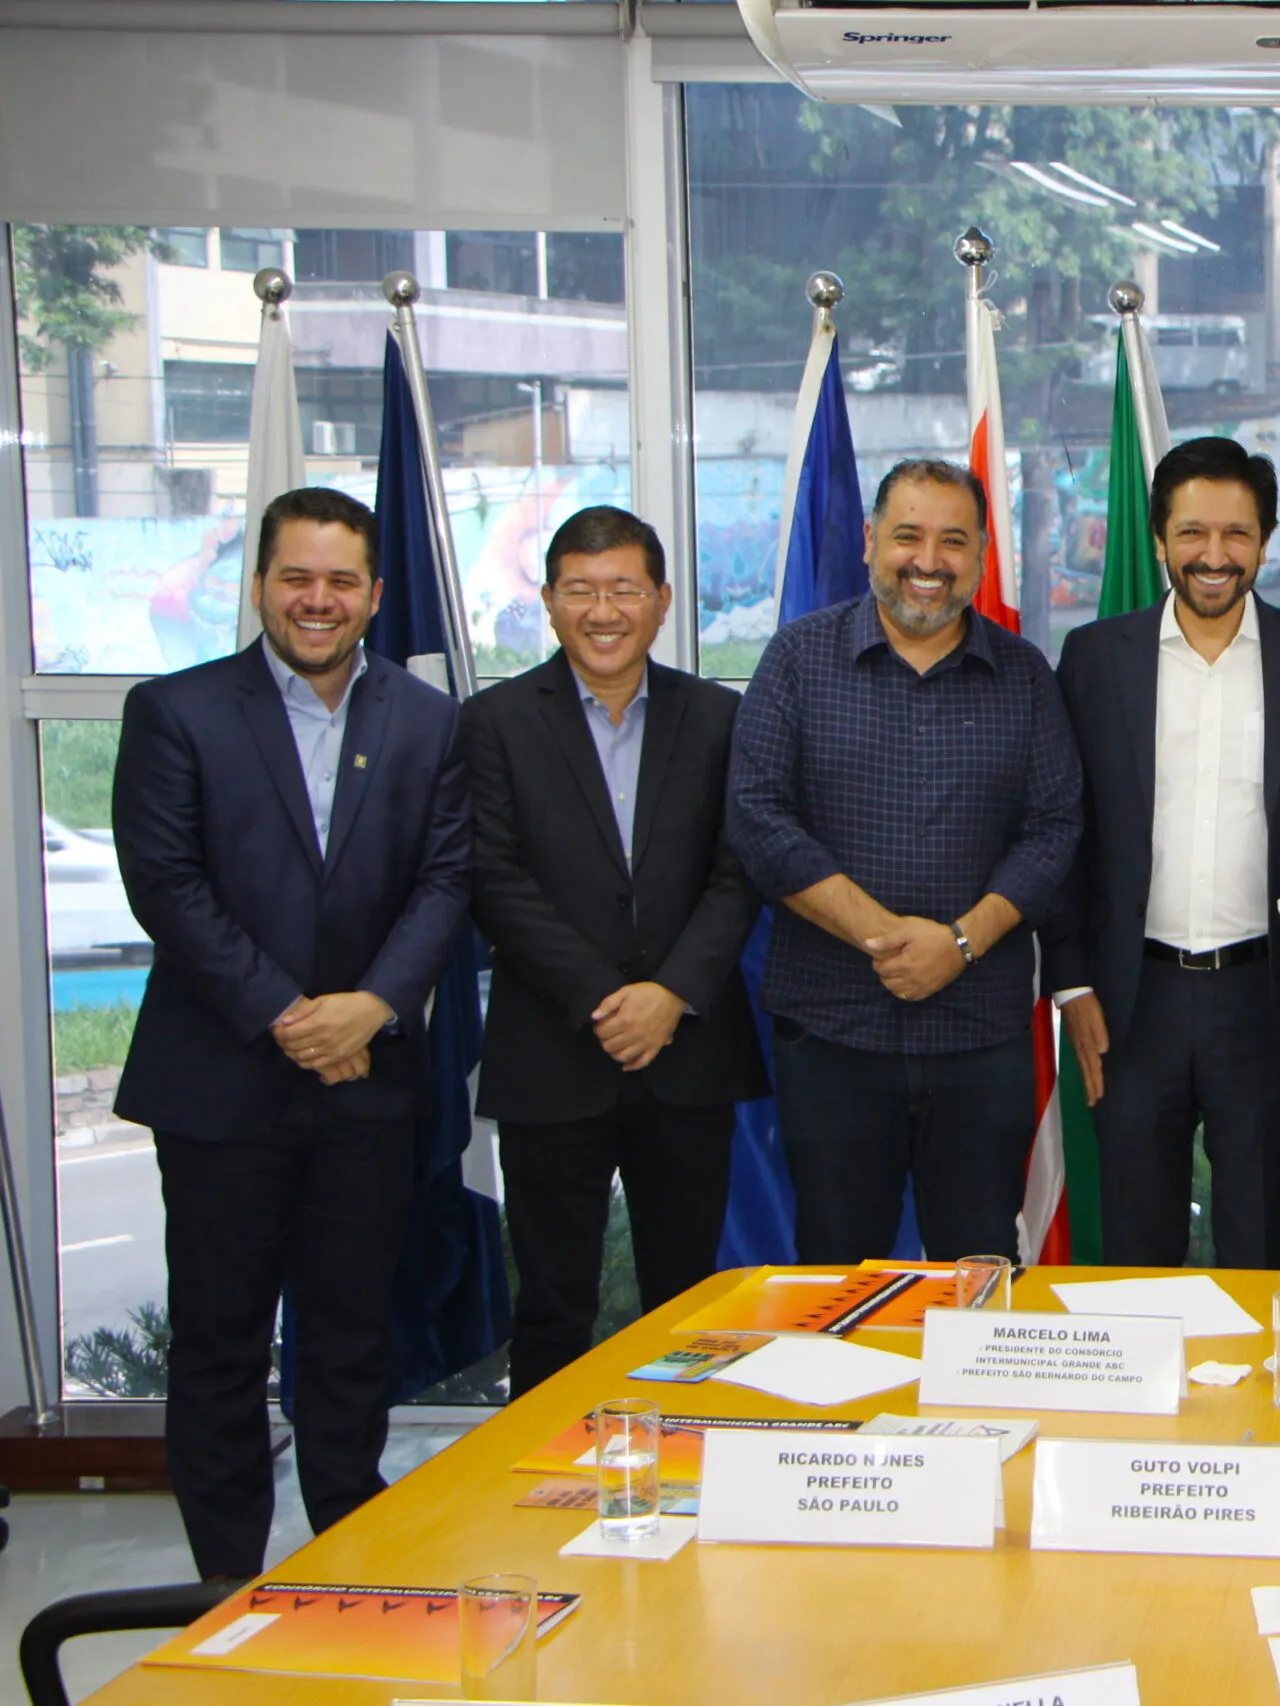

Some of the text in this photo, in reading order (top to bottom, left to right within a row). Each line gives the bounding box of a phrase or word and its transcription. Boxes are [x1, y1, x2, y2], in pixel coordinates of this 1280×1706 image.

[843, 32, 952, 44] Springer
[993, 1327, 1111, 1342] MARCELO LIMA
[984, 1344, 1045, 1354] PRESIDENTE
[1048, 1346, 1061, 1354] DO
[975, 1356, 1125, 1370] INTERMUNICIPAL GRANDE ABC
[962, 1368, 1009, 1377] PREFEITO
[1012, 1369, 1032, 1378] SÃO
[1035, 1371, 1088, 1381] BERNARDO
[1091, 1373, 1105, 1382] DO
[1108, 1374, 1143, 1383] CAMPO
[778, 1452, 858, 1466] RICARDO
[1131, 1460, 1240, 1475] GUTO VOLPI
[806, 1476, 893, 1490] PREFEITO
[1140, 1483, 1229, 1498] PREFEITO
[797, 1495, 899, 1512] SÃO PAULO
[1111, 1504, 1256, 1521] RIBEIRÃO PIRES
